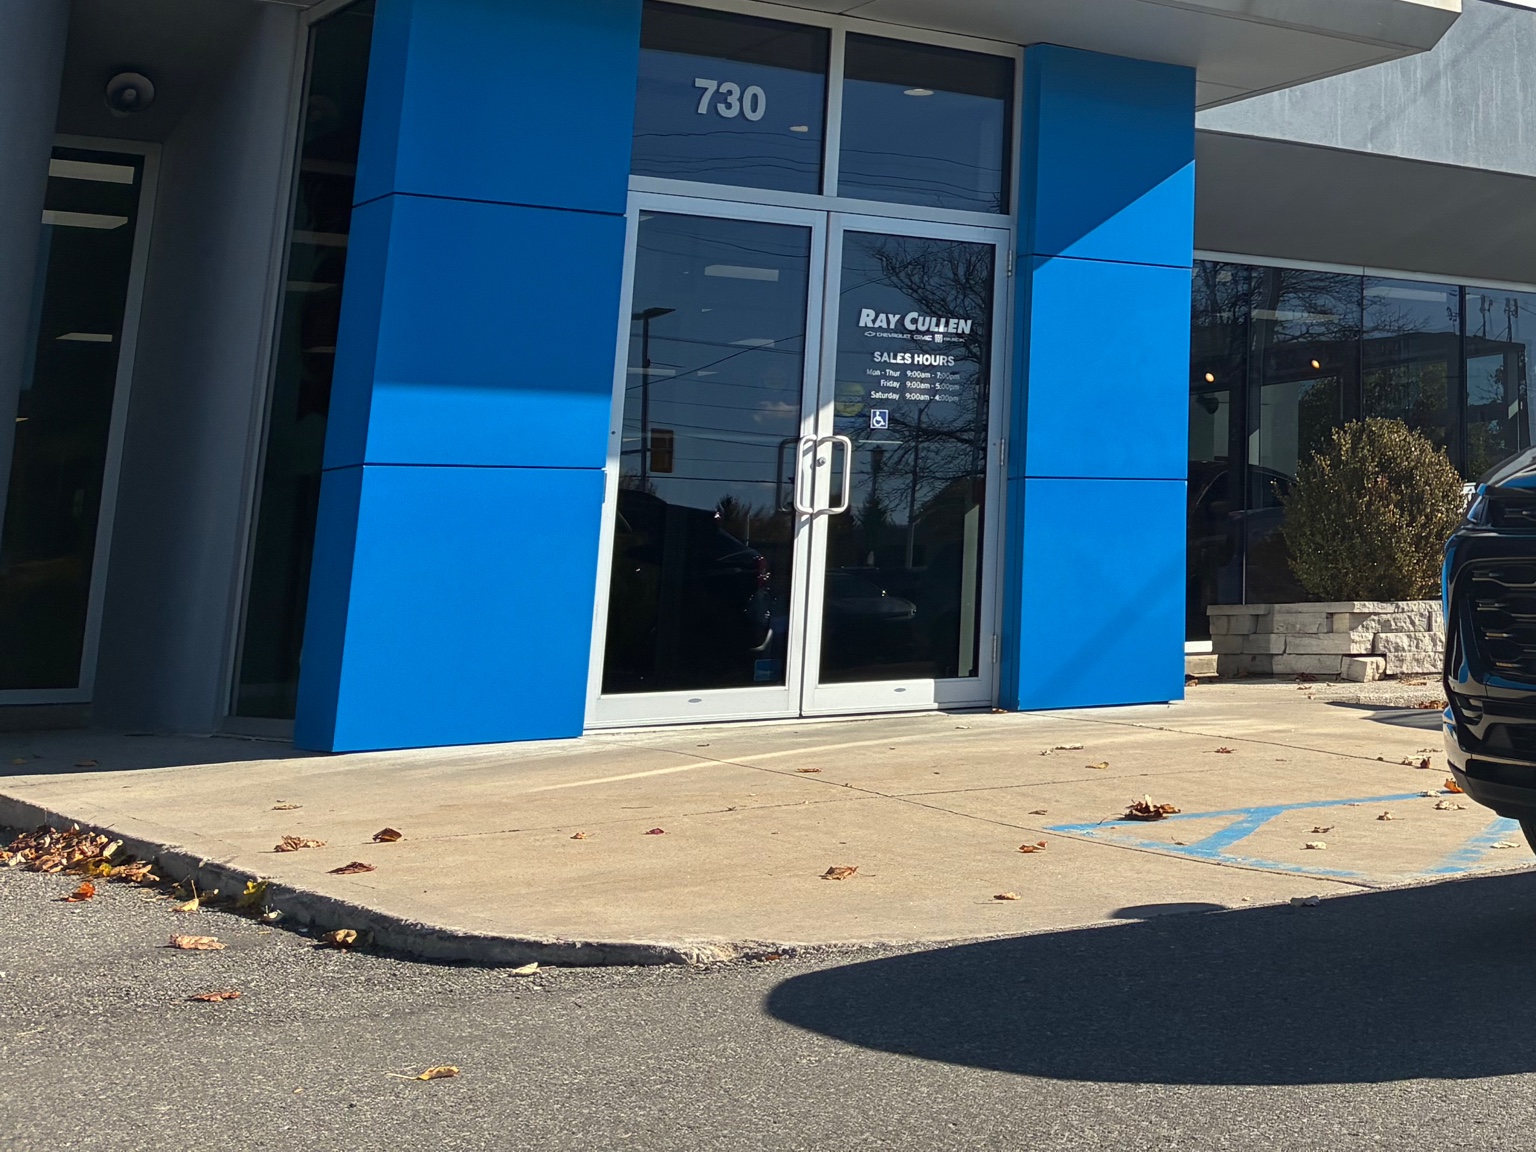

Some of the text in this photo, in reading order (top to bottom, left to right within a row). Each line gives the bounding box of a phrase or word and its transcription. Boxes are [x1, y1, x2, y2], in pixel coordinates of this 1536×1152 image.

[694, 77, 767, 122] 730
[859, 308, 972, 334] RAY CULLEN
[873, 351, 955, 366] SALES HOURS
[866, 368, 881, 376] Mon
[886, 369, 901, 377] Thur
[906, 370, 931, 378] 9:00am
[936, 372, 960, 380] 7:00pm
[880, 379, 900, 388] Friday
[905, 381, 930, 389] 9:00am
[935, 382, 960, 391] 5:00pm
[870, 390, 900, 401] Saturday
[905, 392, 930, 401] 9:00am
[934, 394, 959, 403] 4:00pm
